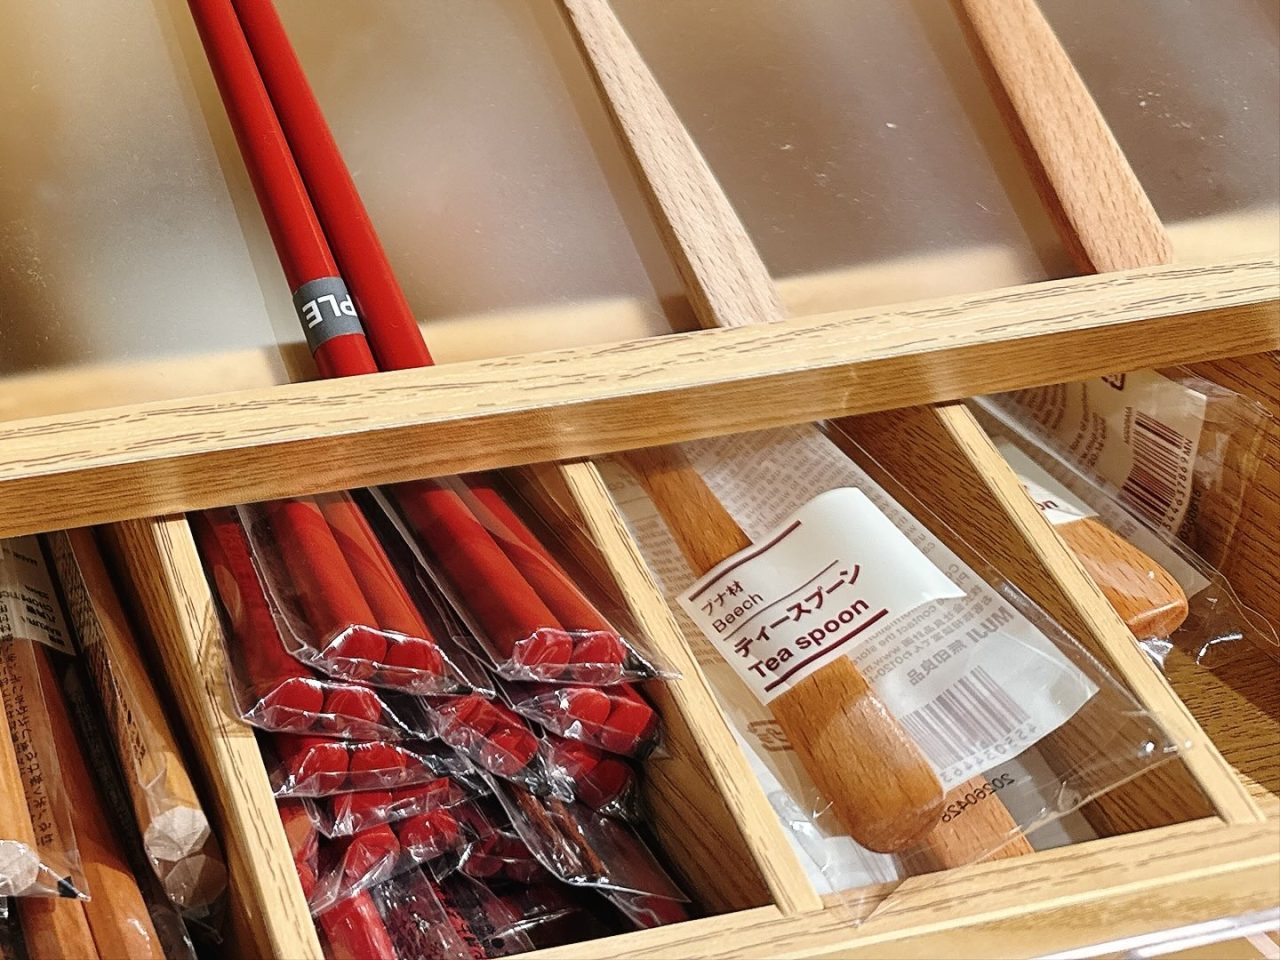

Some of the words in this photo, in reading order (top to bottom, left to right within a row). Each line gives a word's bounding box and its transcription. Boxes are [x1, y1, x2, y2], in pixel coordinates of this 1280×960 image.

[302, 294, 357, 328] PLE
[701, 580, 744, 616] ブナ材
[712, 592, 764, 633] Beech
[734, 564, 860, 658] ティースプーン
[748, 647, 795, 678] Tea
[795, 599, 870, 650] spoon
